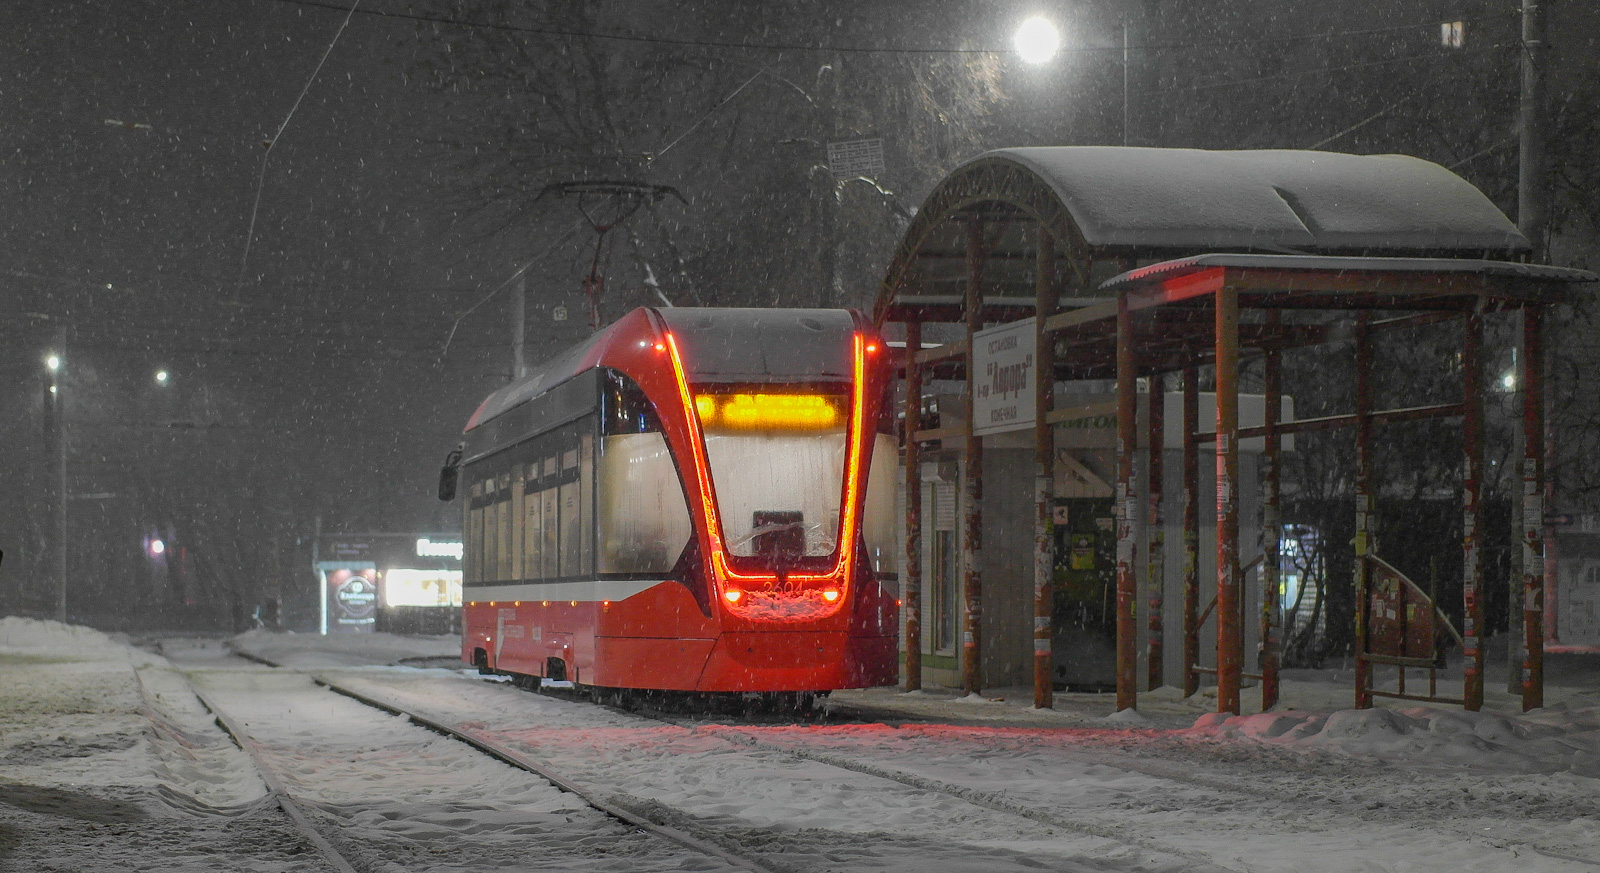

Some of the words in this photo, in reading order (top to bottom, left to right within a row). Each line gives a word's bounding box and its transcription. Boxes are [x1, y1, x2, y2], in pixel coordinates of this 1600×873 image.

[988, 336, 1017, 355] ОСТАНОВКА
[991, 406, 1017, 422] КОНЕЧНАЯ
[764, 581, 803, 593] 2604
